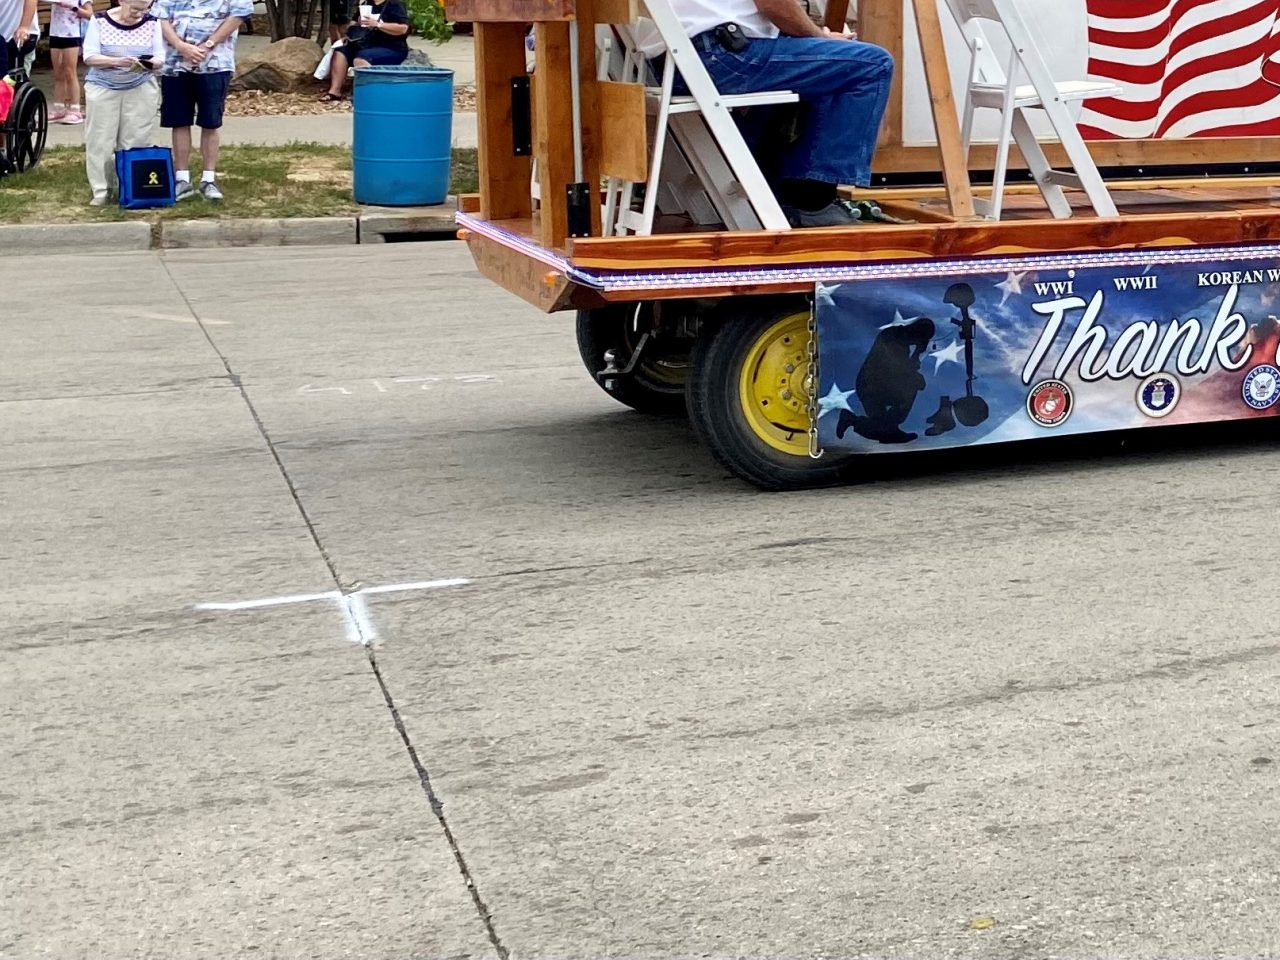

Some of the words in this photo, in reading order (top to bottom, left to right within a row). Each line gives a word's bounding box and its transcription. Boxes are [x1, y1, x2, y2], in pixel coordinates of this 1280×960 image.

[1034, 281, 1074, 296] WWI
[1114, 276, 1157, 291] WWII
[1197, 270, 1264, 286] KOREAN
[1022, 284, 1253, 385] Thank
[1246, 366, 1265, 397] UNITED
[1252, 398, 1274, 407] NAVY
